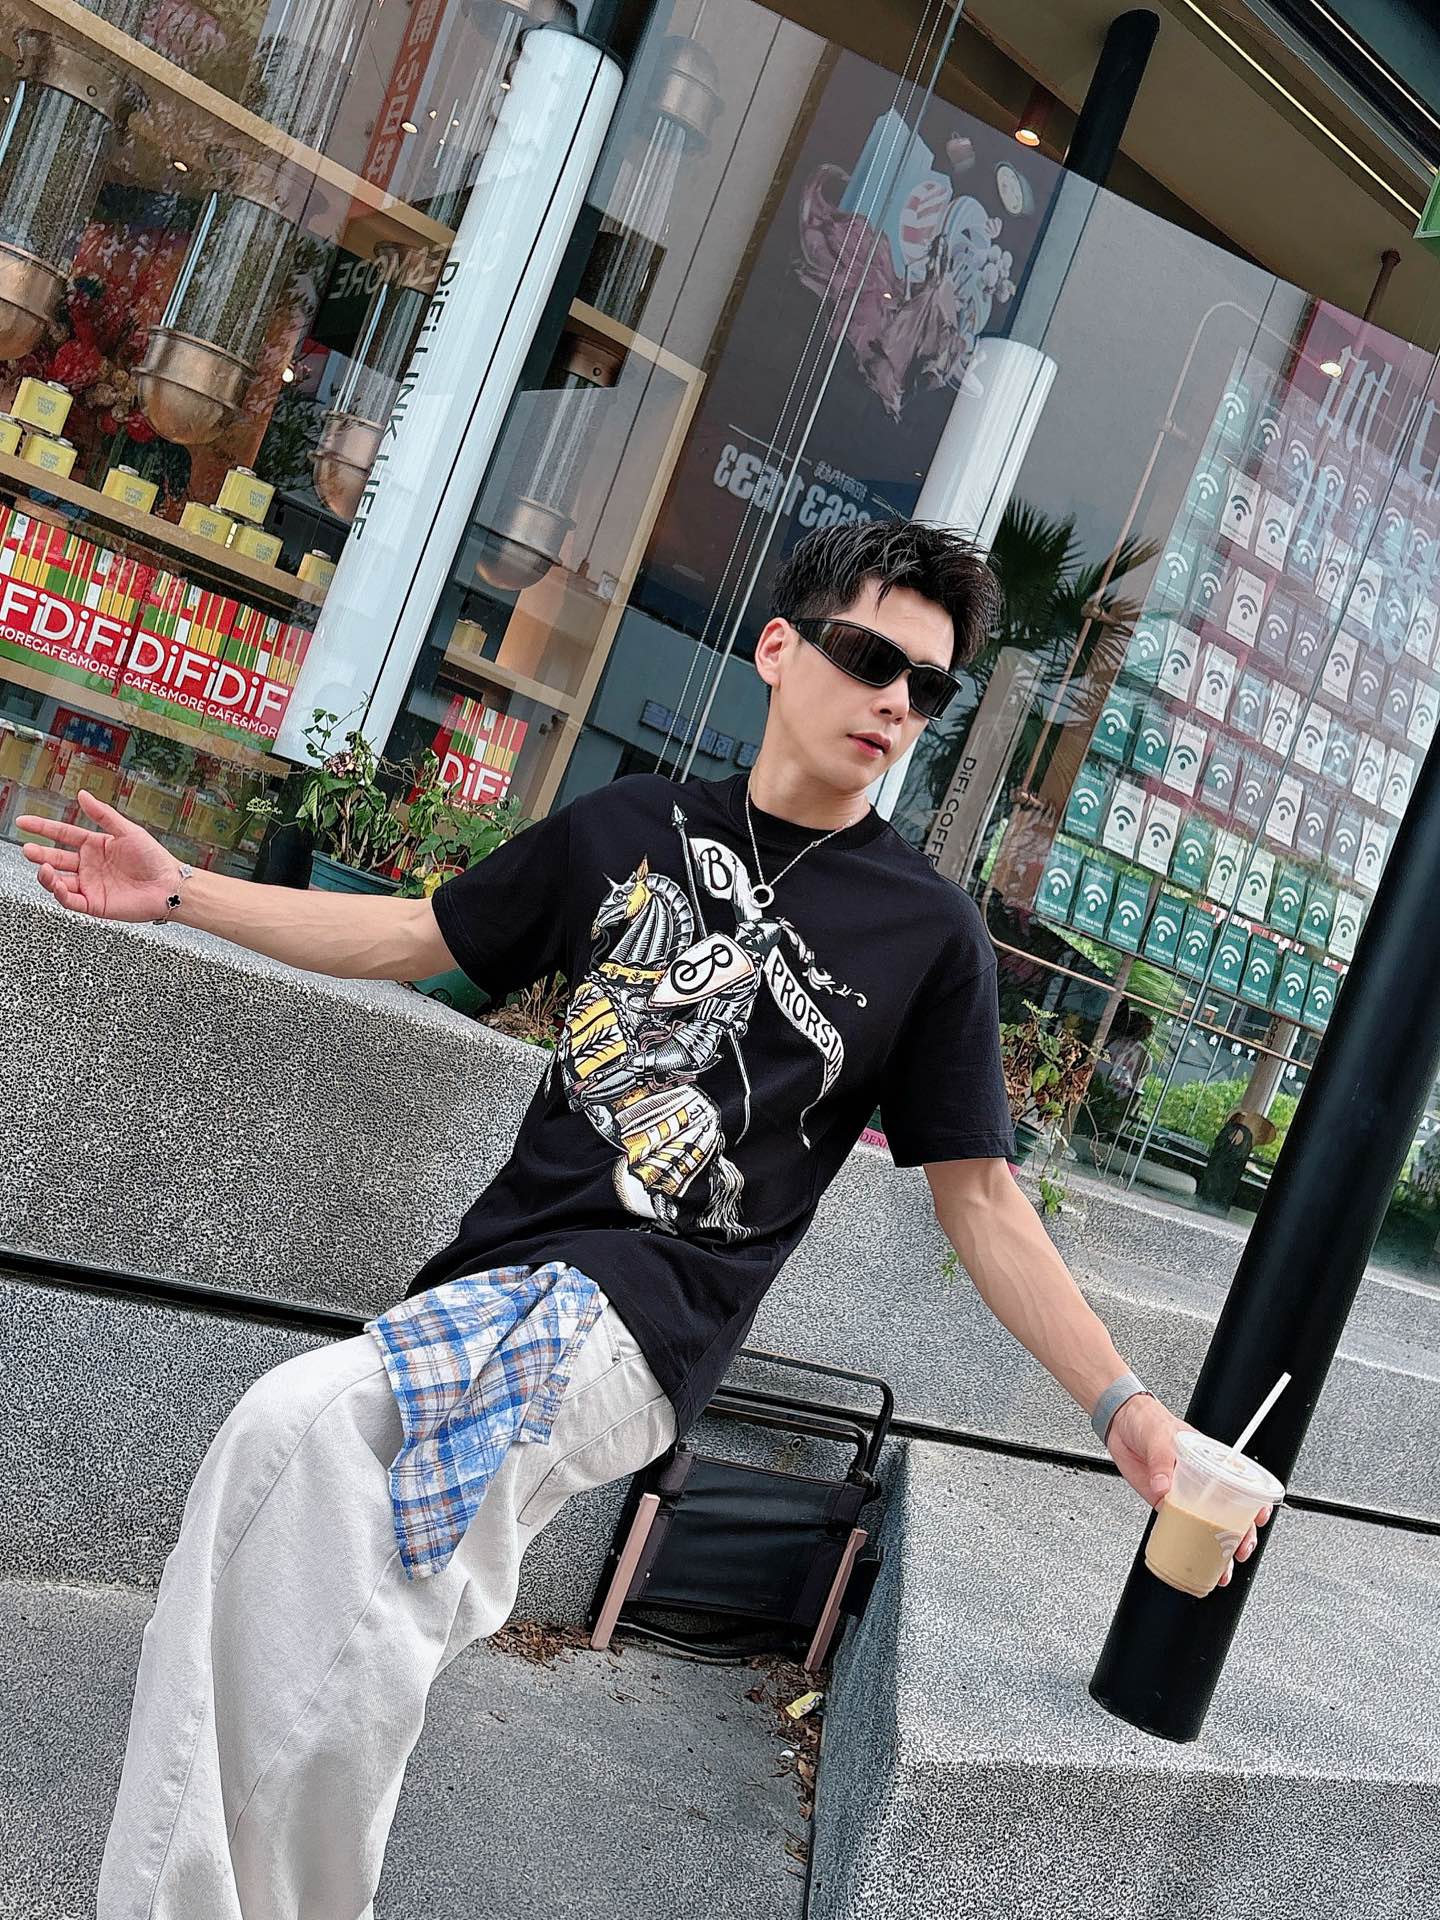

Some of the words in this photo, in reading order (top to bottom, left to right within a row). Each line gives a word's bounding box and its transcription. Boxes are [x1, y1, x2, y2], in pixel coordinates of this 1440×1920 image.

[421, 261, 460, 332] DiFi
[31, 639, 118, 680] CAFE&MORE
[123, 672, 204, 712] CAFE&MORE
[36, 596, 133, 666] DiFi
[127, 632, 221, 699] DiFi
[436, 751, 512, 801] DiFi
[952, 757, 978, 794] DiFi
[699, 845, 733, 891] B
